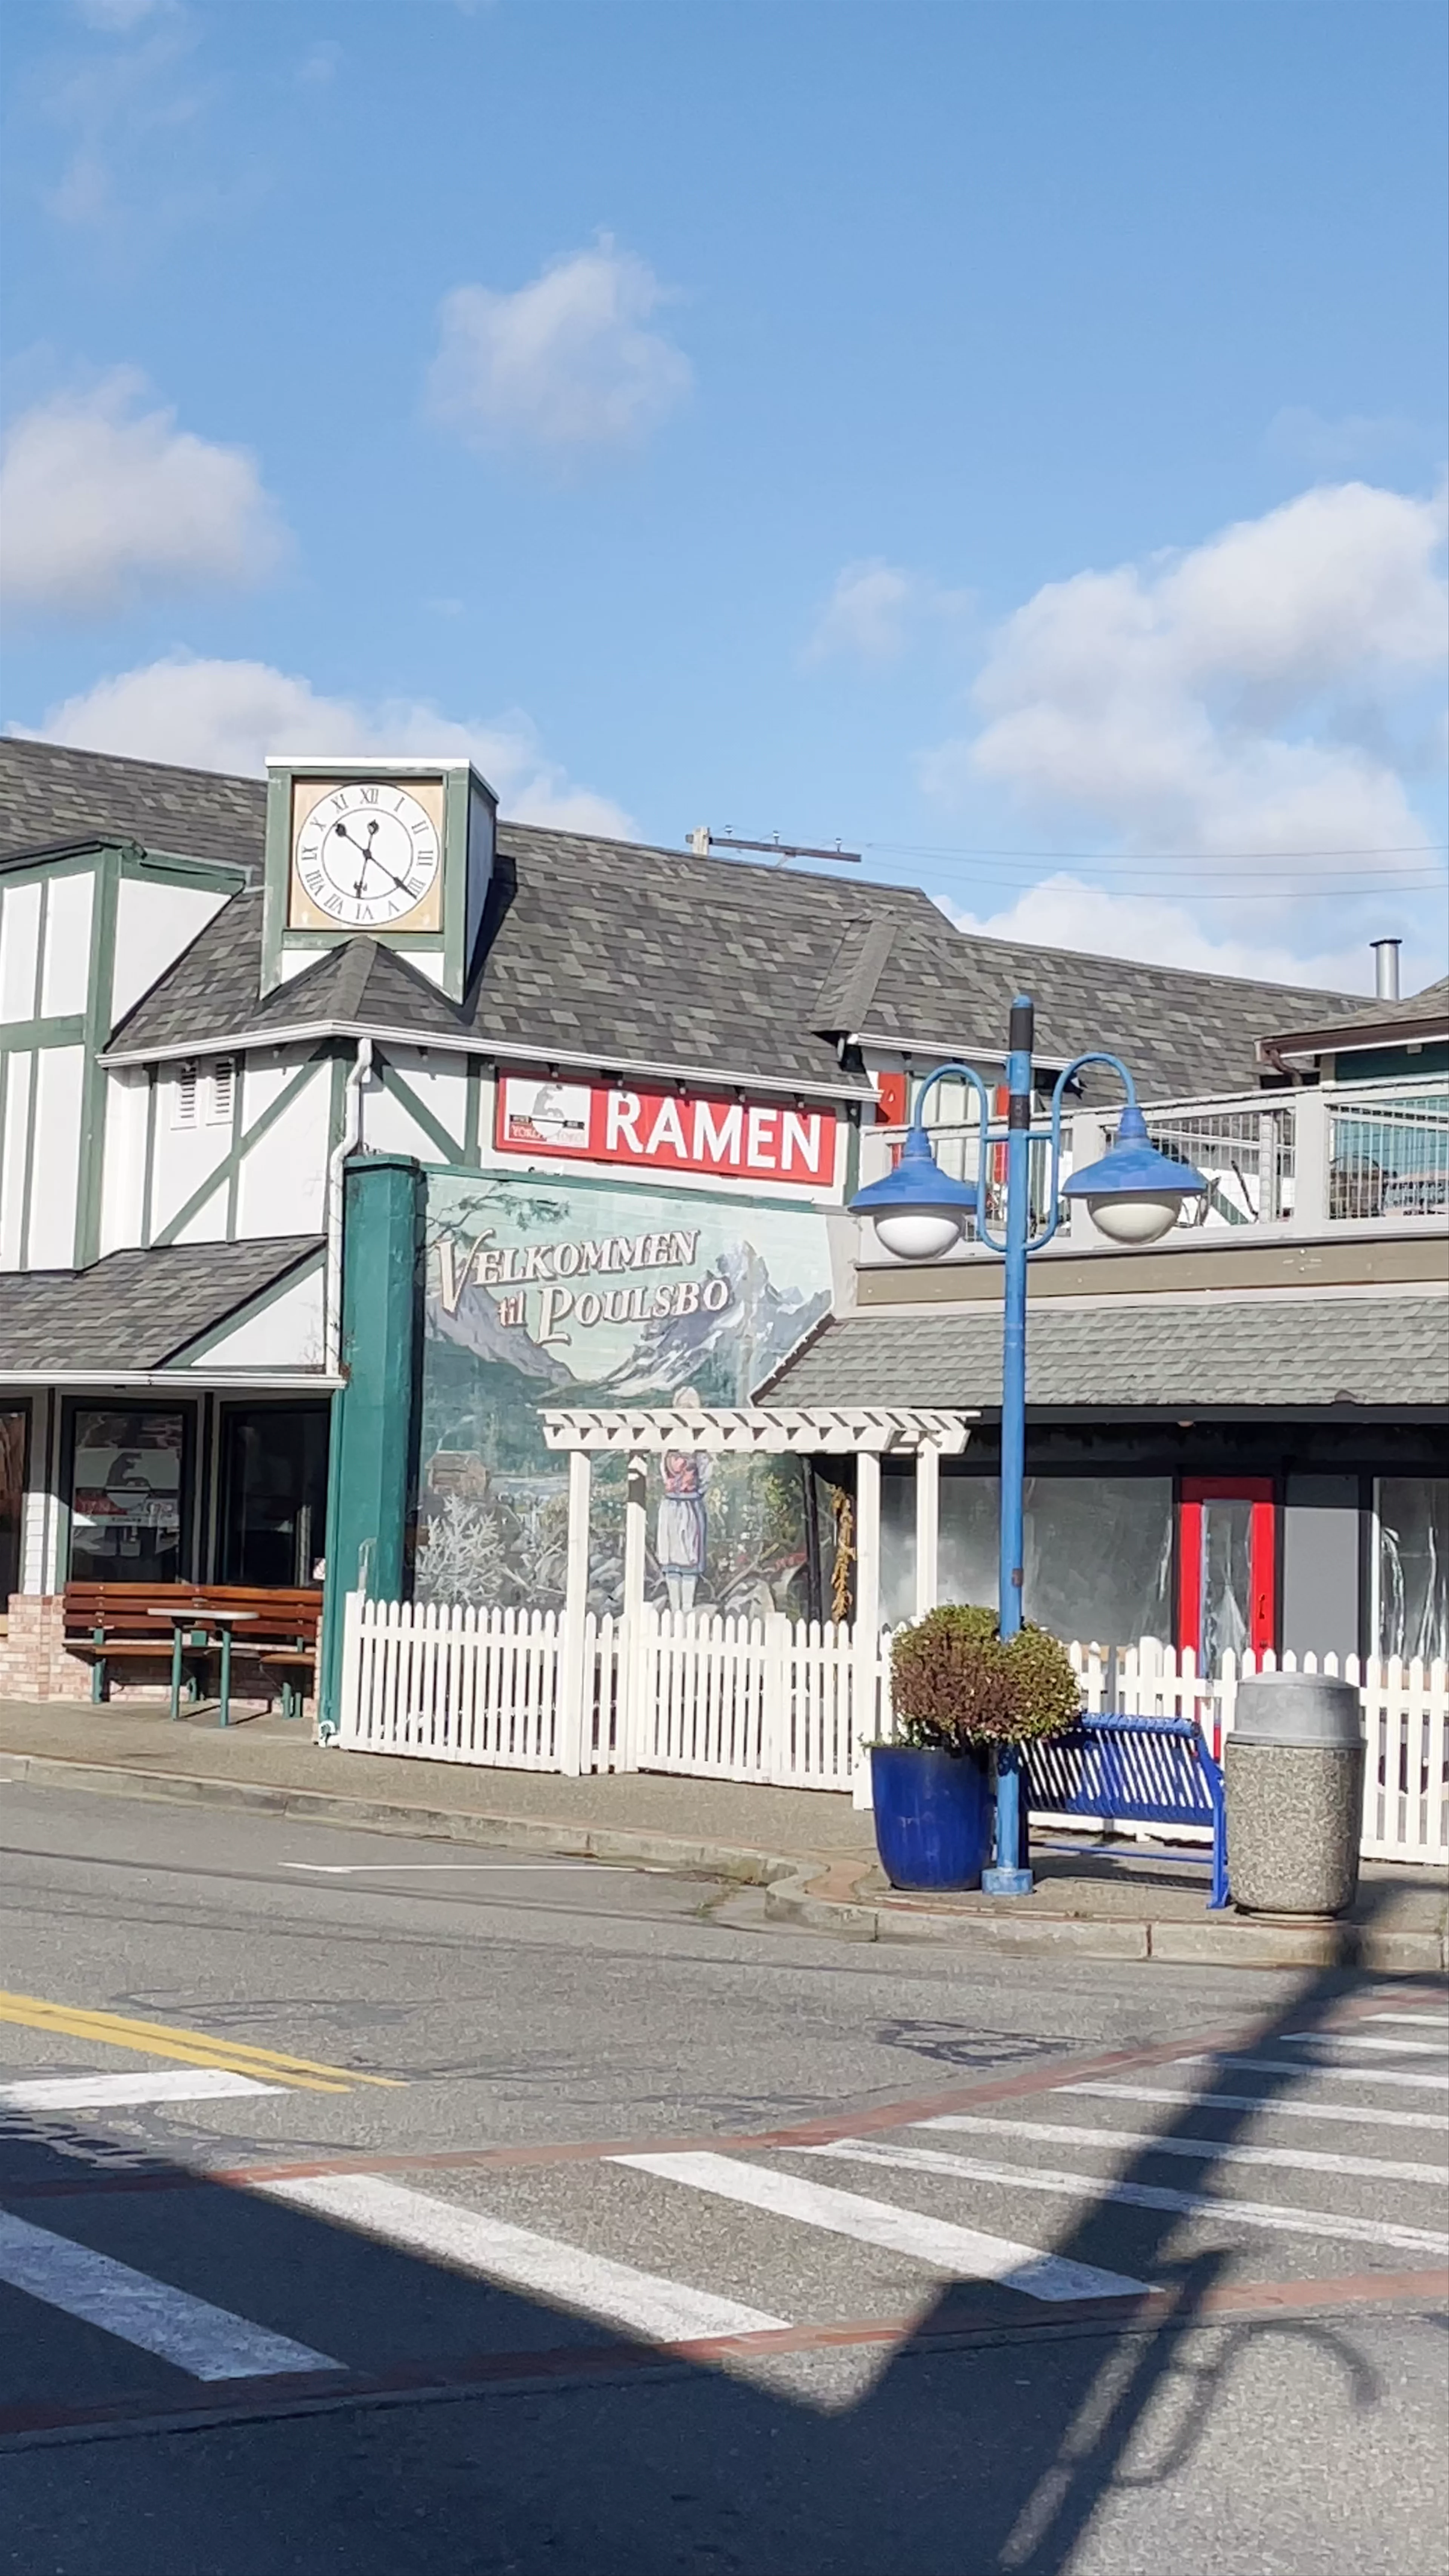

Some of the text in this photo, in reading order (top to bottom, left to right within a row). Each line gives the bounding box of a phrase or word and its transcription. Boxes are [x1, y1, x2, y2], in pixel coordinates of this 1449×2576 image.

[330, 794, 349, 814] XI
[360, 788, 379, 804] XII
[309, 816, 327, 832] X
[411, 820, 429, 835] II
[301, 846, 318, 861] IX
[416, 850, 433, 866] III
[407, 877, 426, 900] III
[356, 903, 374, 920] VI
[388, 900, 400, 917] V
[606, 1089, 821, 1173] RAMEN
[435, 1228, 701, 1315] VELKOMMEN
[497, 1278, 734, 1346] til POULSBO
